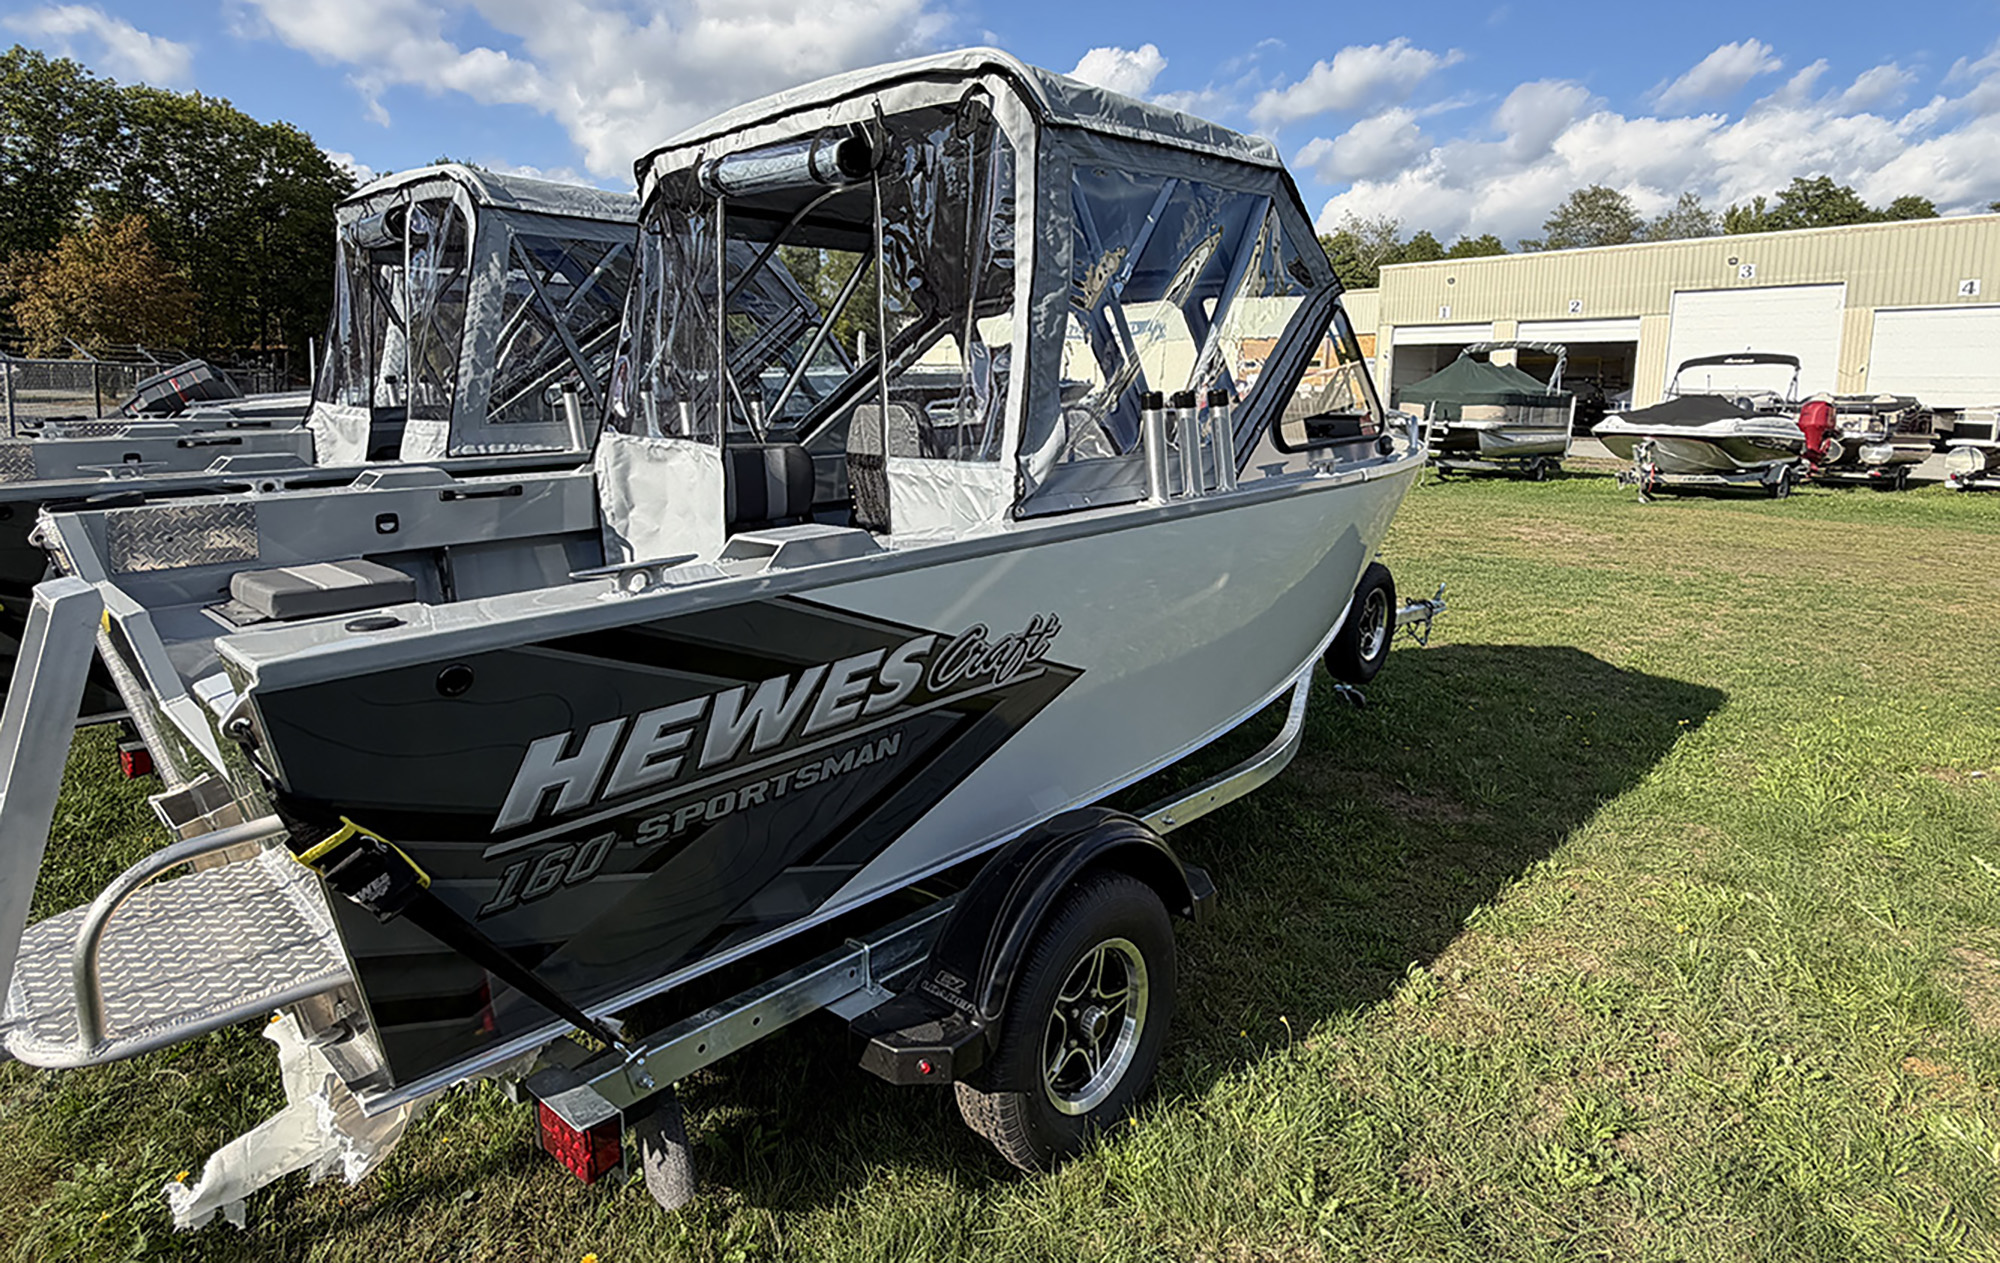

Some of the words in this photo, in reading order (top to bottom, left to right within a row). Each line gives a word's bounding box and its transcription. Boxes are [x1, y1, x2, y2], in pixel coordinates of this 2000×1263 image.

[1741, 265, 1753, 278] 3
[1962, 281, 1977, 294] 4
[1570, 301, 1580, 313] 2
[491, 634, 937, 833] HEWES
[926, 611, 1063, 693] Craft
[476, 830, 616, 920] 160
[634, 731, 904, 846] SPORTSMAN
